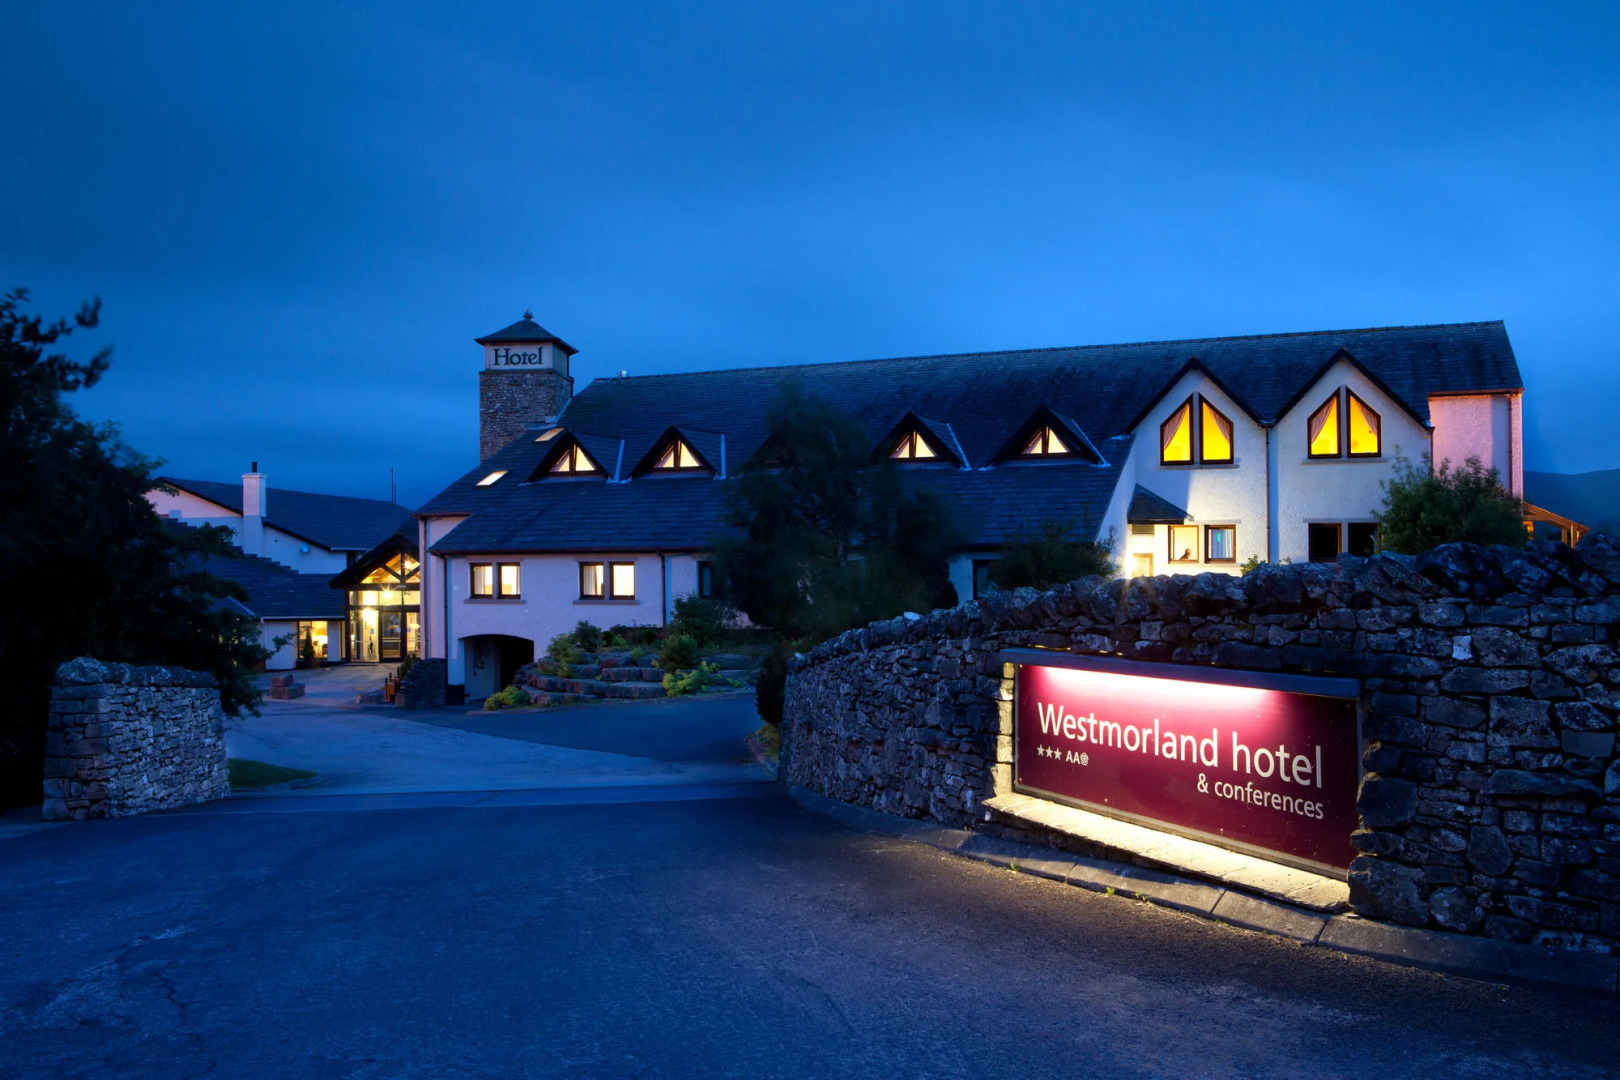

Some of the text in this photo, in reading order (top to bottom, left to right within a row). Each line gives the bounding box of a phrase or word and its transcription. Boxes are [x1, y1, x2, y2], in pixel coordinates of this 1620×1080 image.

[493, 346, 543, 365] Hotel
[1038, 702, 1322, 788] Westmorland hotel
[1197, 773, 1324, 820] & conferences
